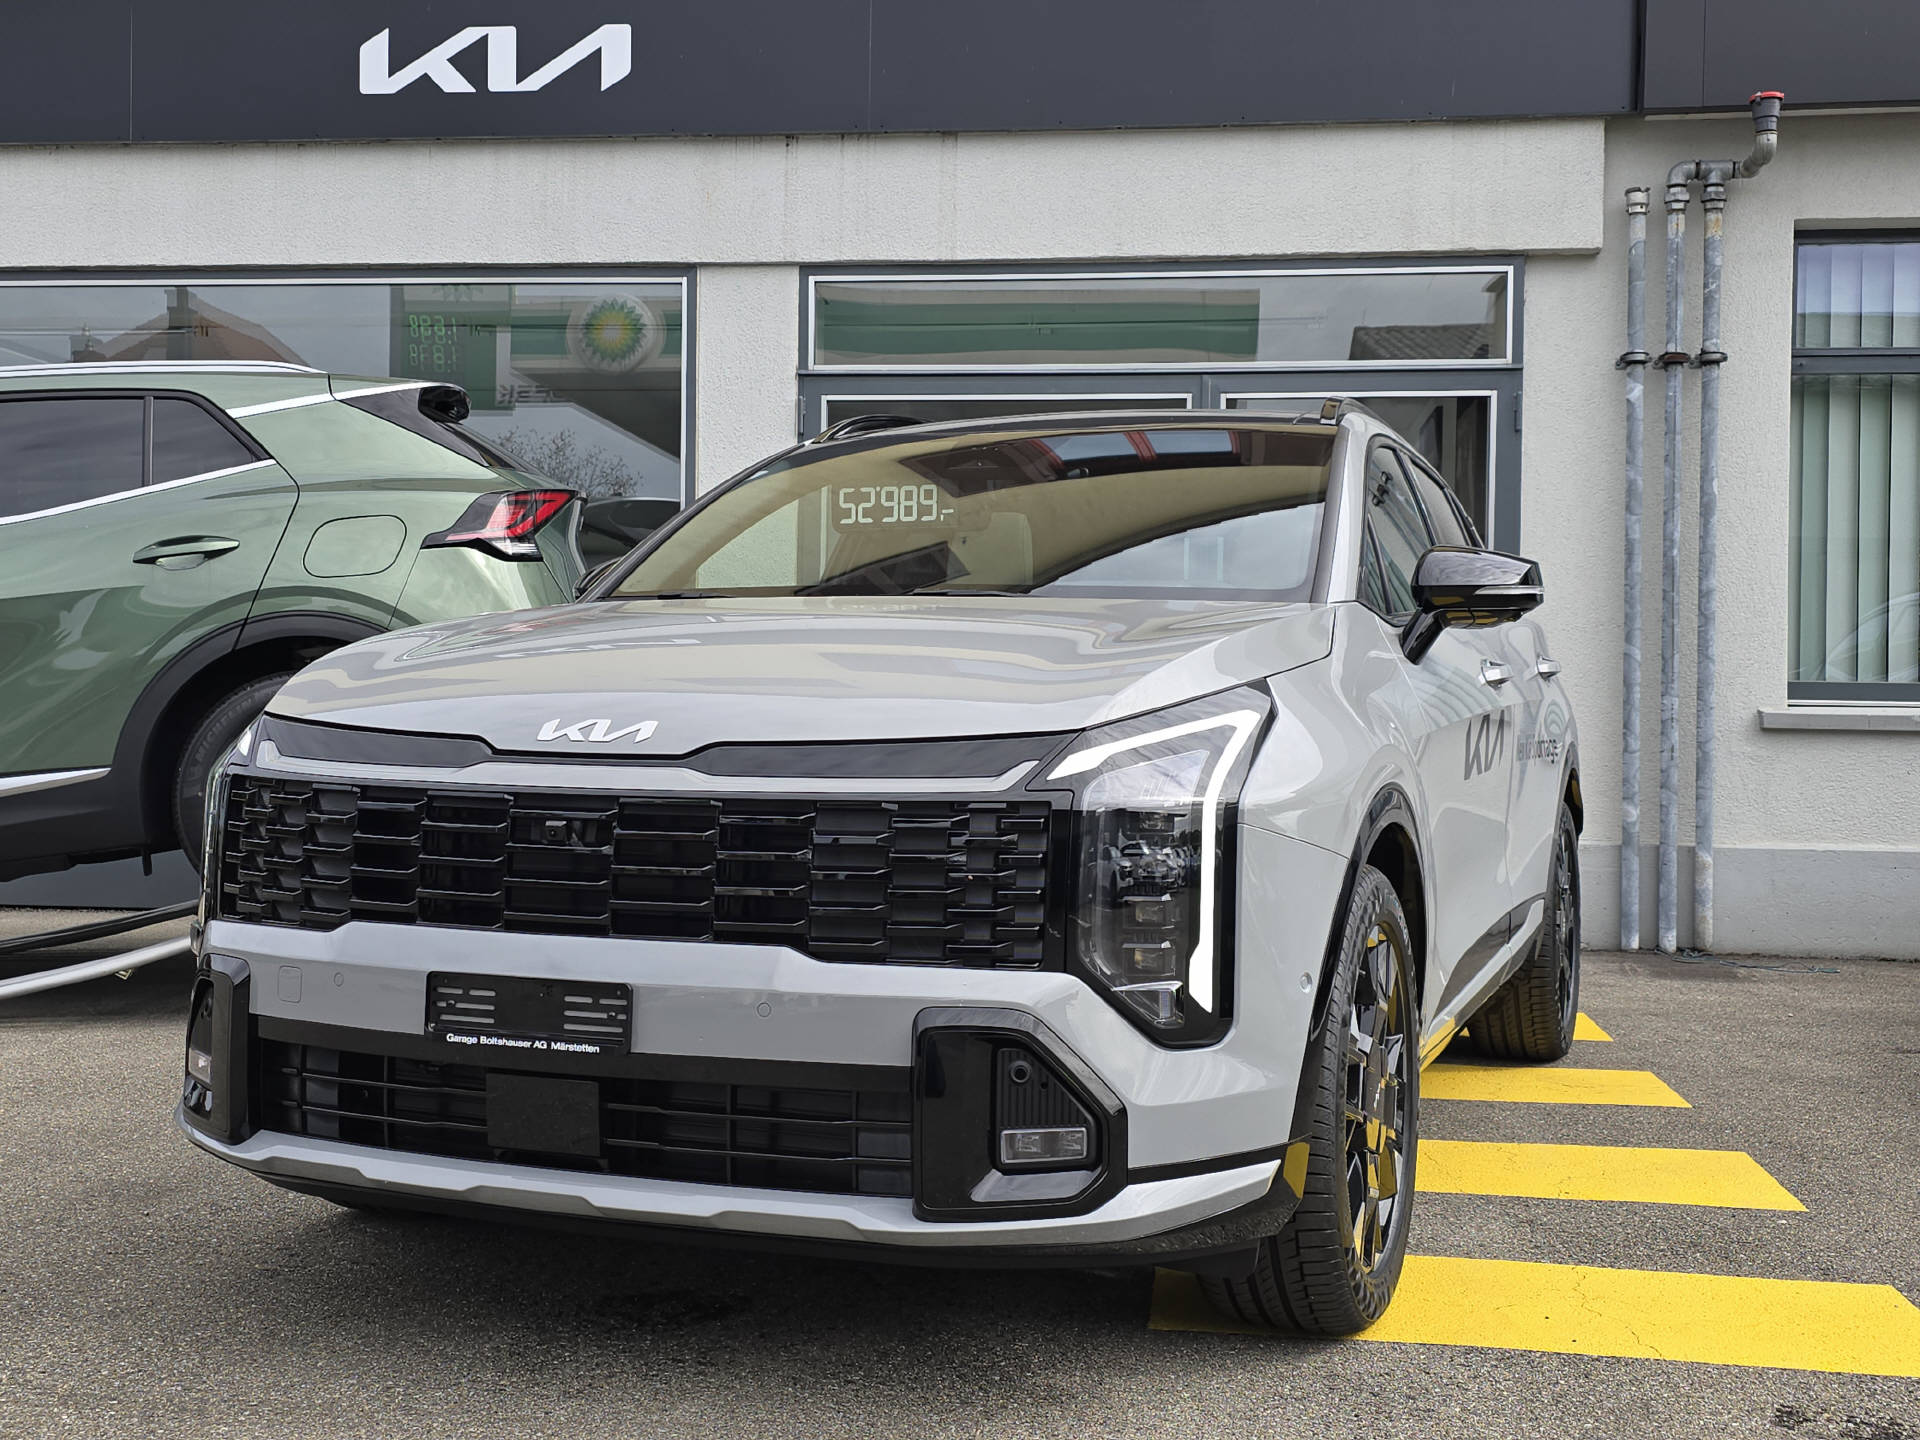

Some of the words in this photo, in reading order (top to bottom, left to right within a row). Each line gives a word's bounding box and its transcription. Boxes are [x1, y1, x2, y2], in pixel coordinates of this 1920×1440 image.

[360, 24, 631, 94] KIA
[536, 718, 659, 744] KIA
[1463, 709, 1505, 781] KIA
[446, 1033, 478, 1045] Garage
[480, 1035, 532, 1048] Boltshauser
[533, 1040, 548, 1049] AG
[551, 1041, 600, 1053] Märstetten
